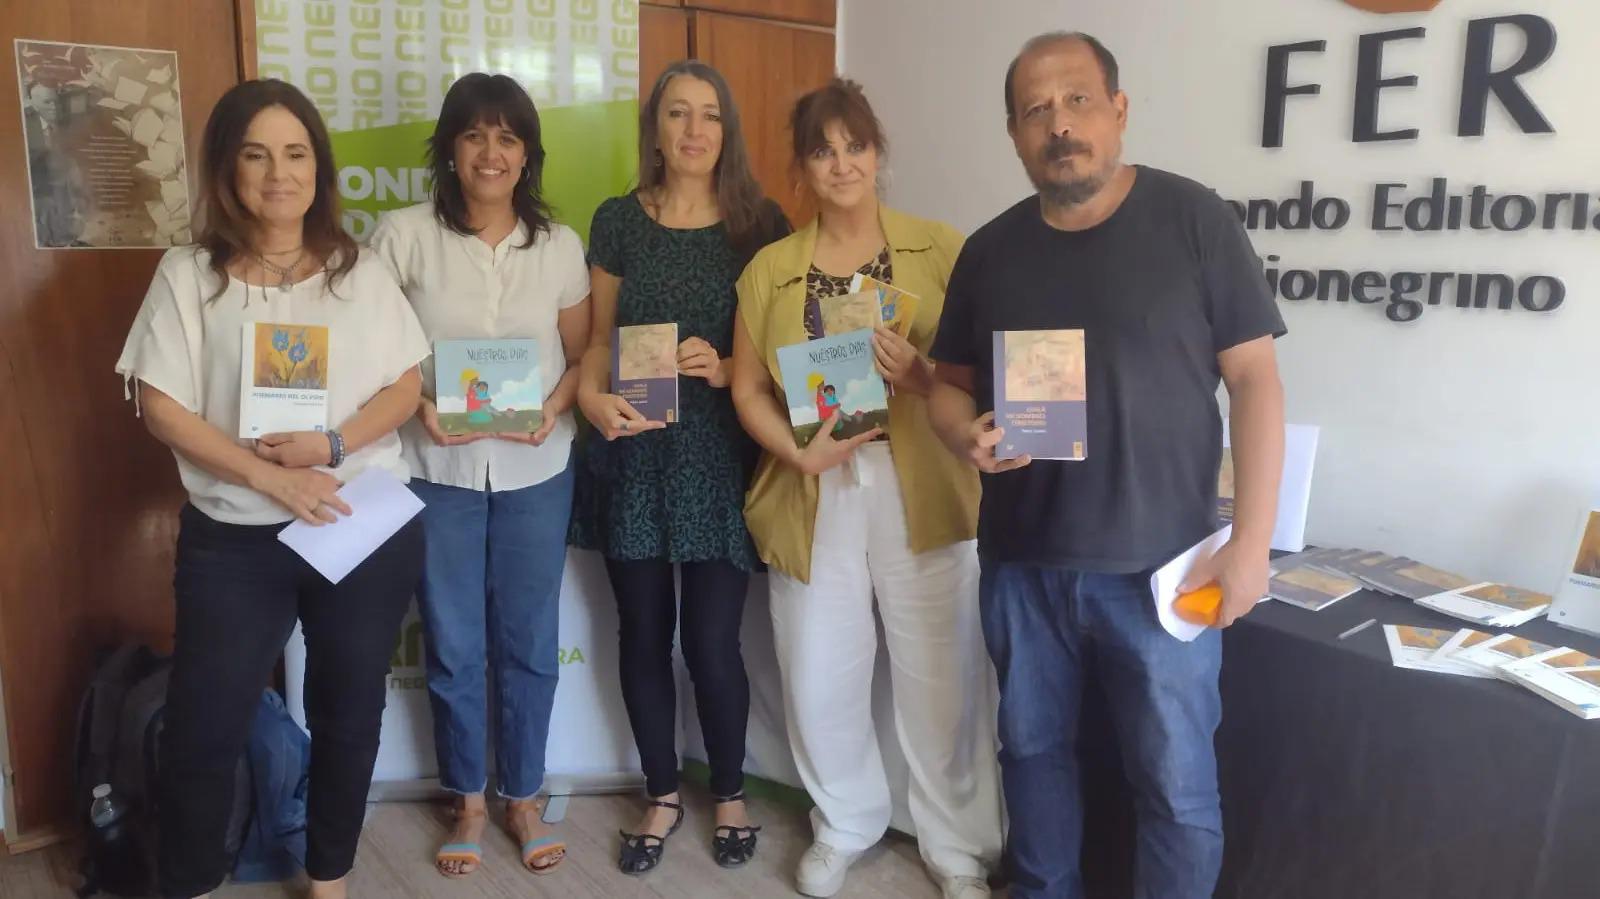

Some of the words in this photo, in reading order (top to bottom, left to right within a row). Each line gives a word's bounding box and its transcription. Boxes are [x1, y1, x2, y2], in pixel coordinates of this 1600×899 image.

[1262, 14, 1558, 148] FER
[1209, 181, 1351, 230] ndo
[1371, 177, 1600, 231] Editori
[1259, 255, 1566, 321] ionegrino
